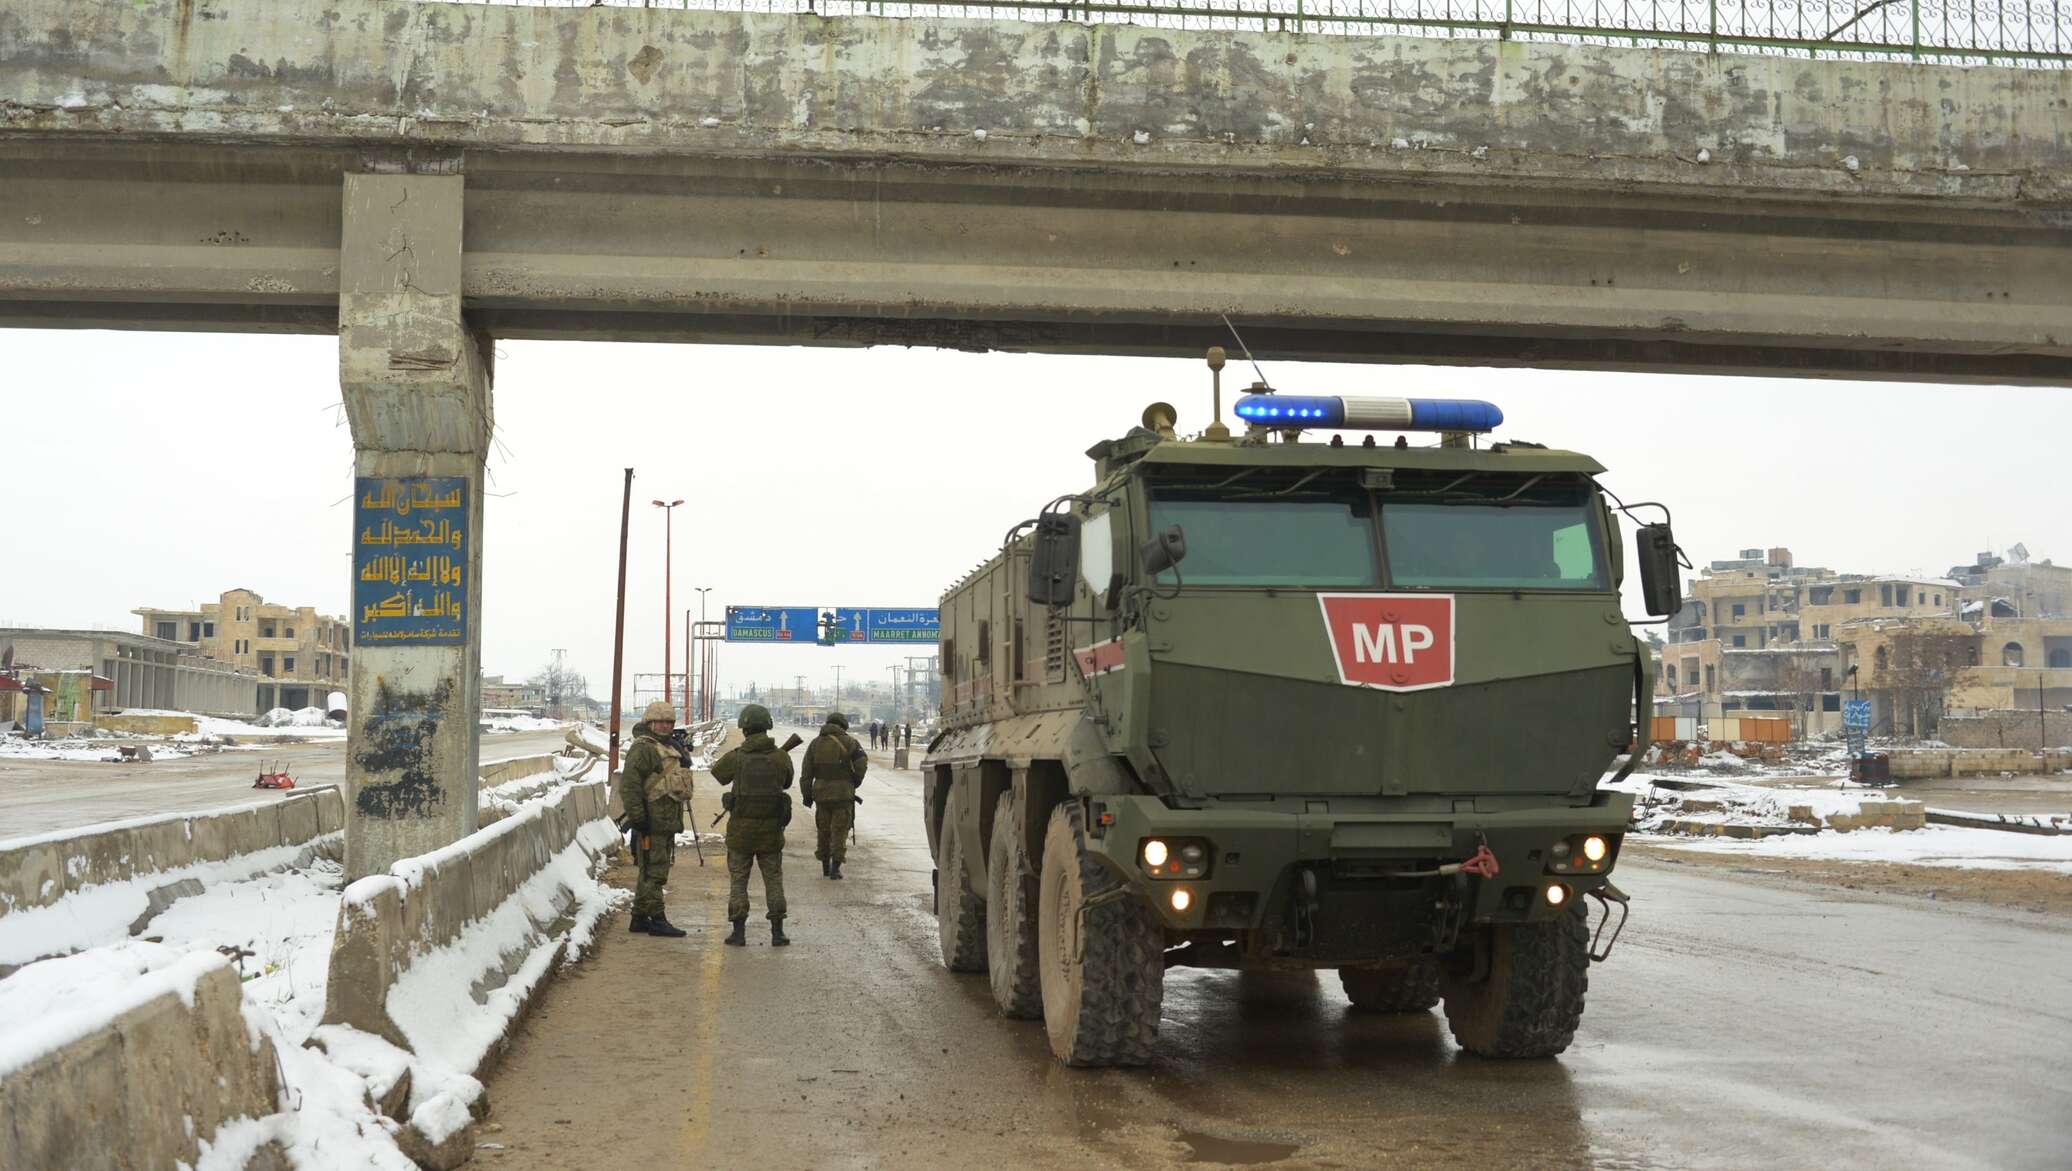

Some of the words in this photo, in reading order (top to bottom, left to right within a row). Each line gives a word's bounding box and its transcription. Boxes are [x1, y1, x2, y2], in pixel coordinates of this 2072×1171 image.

[361, 484, 394, 509] الله
[361, 516, 392, 545] لله
[361, 553, 389, 581] الله
[360, 588, 413, 624] أكبر
[412, 588, 461, 622] والله
[919, 613, 941, 625] عرة
[732, 627, 772, 638] DAMASCUS
[873, 630, 910, 640] MAARRET
[1352, 623, 1434, 664] MP
